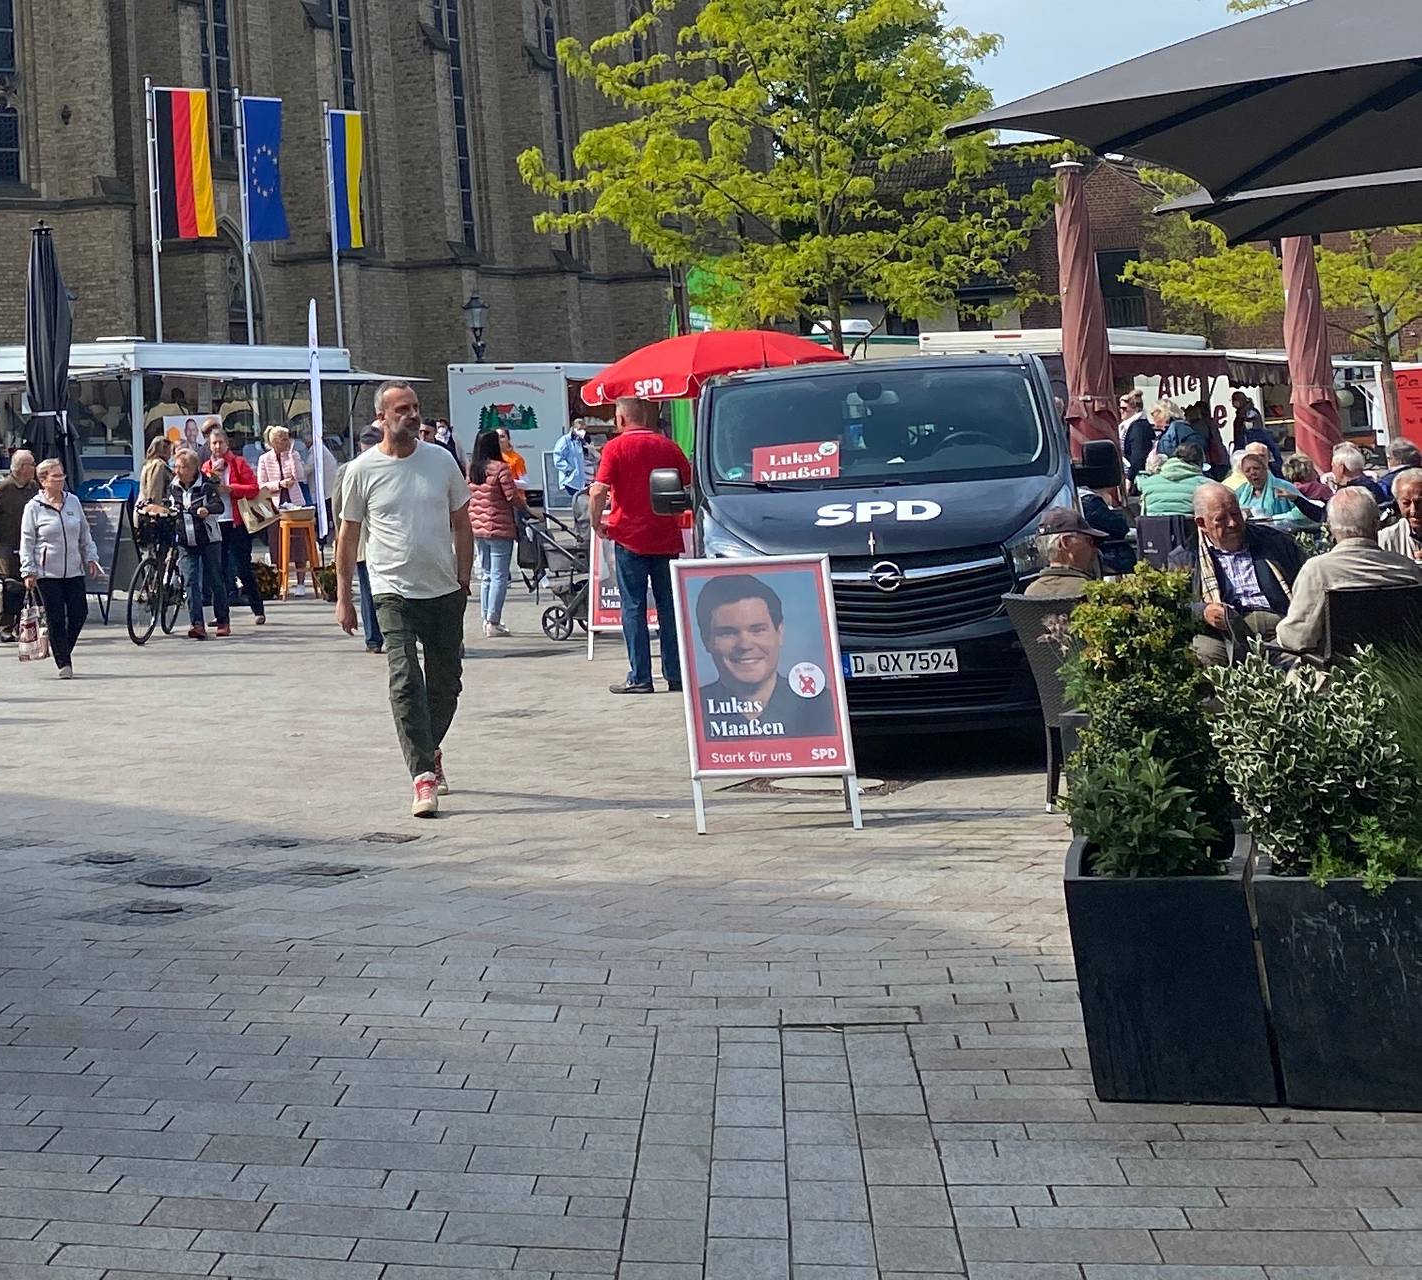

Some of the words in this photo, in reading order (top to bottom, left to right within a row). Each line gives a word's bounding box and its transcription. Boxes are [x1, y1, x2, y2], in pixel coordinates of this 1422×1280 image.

[634, 378, 664, 396] SPD
[769, 452, 823, 466] Lukas
[760, 467, 832, 482] Maaßen
[814, 500, 942, 526] SPD
[601, 586, 620, 597] Luk
[601, 599, 621, 609] Maa
[852, 656, 865, 673] D
[878, 653, 903, 672] QX
[905, 651, 955, 671] 7594
[707, 697, 764, 715] Lukas
[710, 718, 785, 737] Maaßen
[711, 752, 746, 763] Stark
[748, 752, 767, 763] für
[771, 752, 792, 762] uns
[811, 747, 838, 761] SPD
